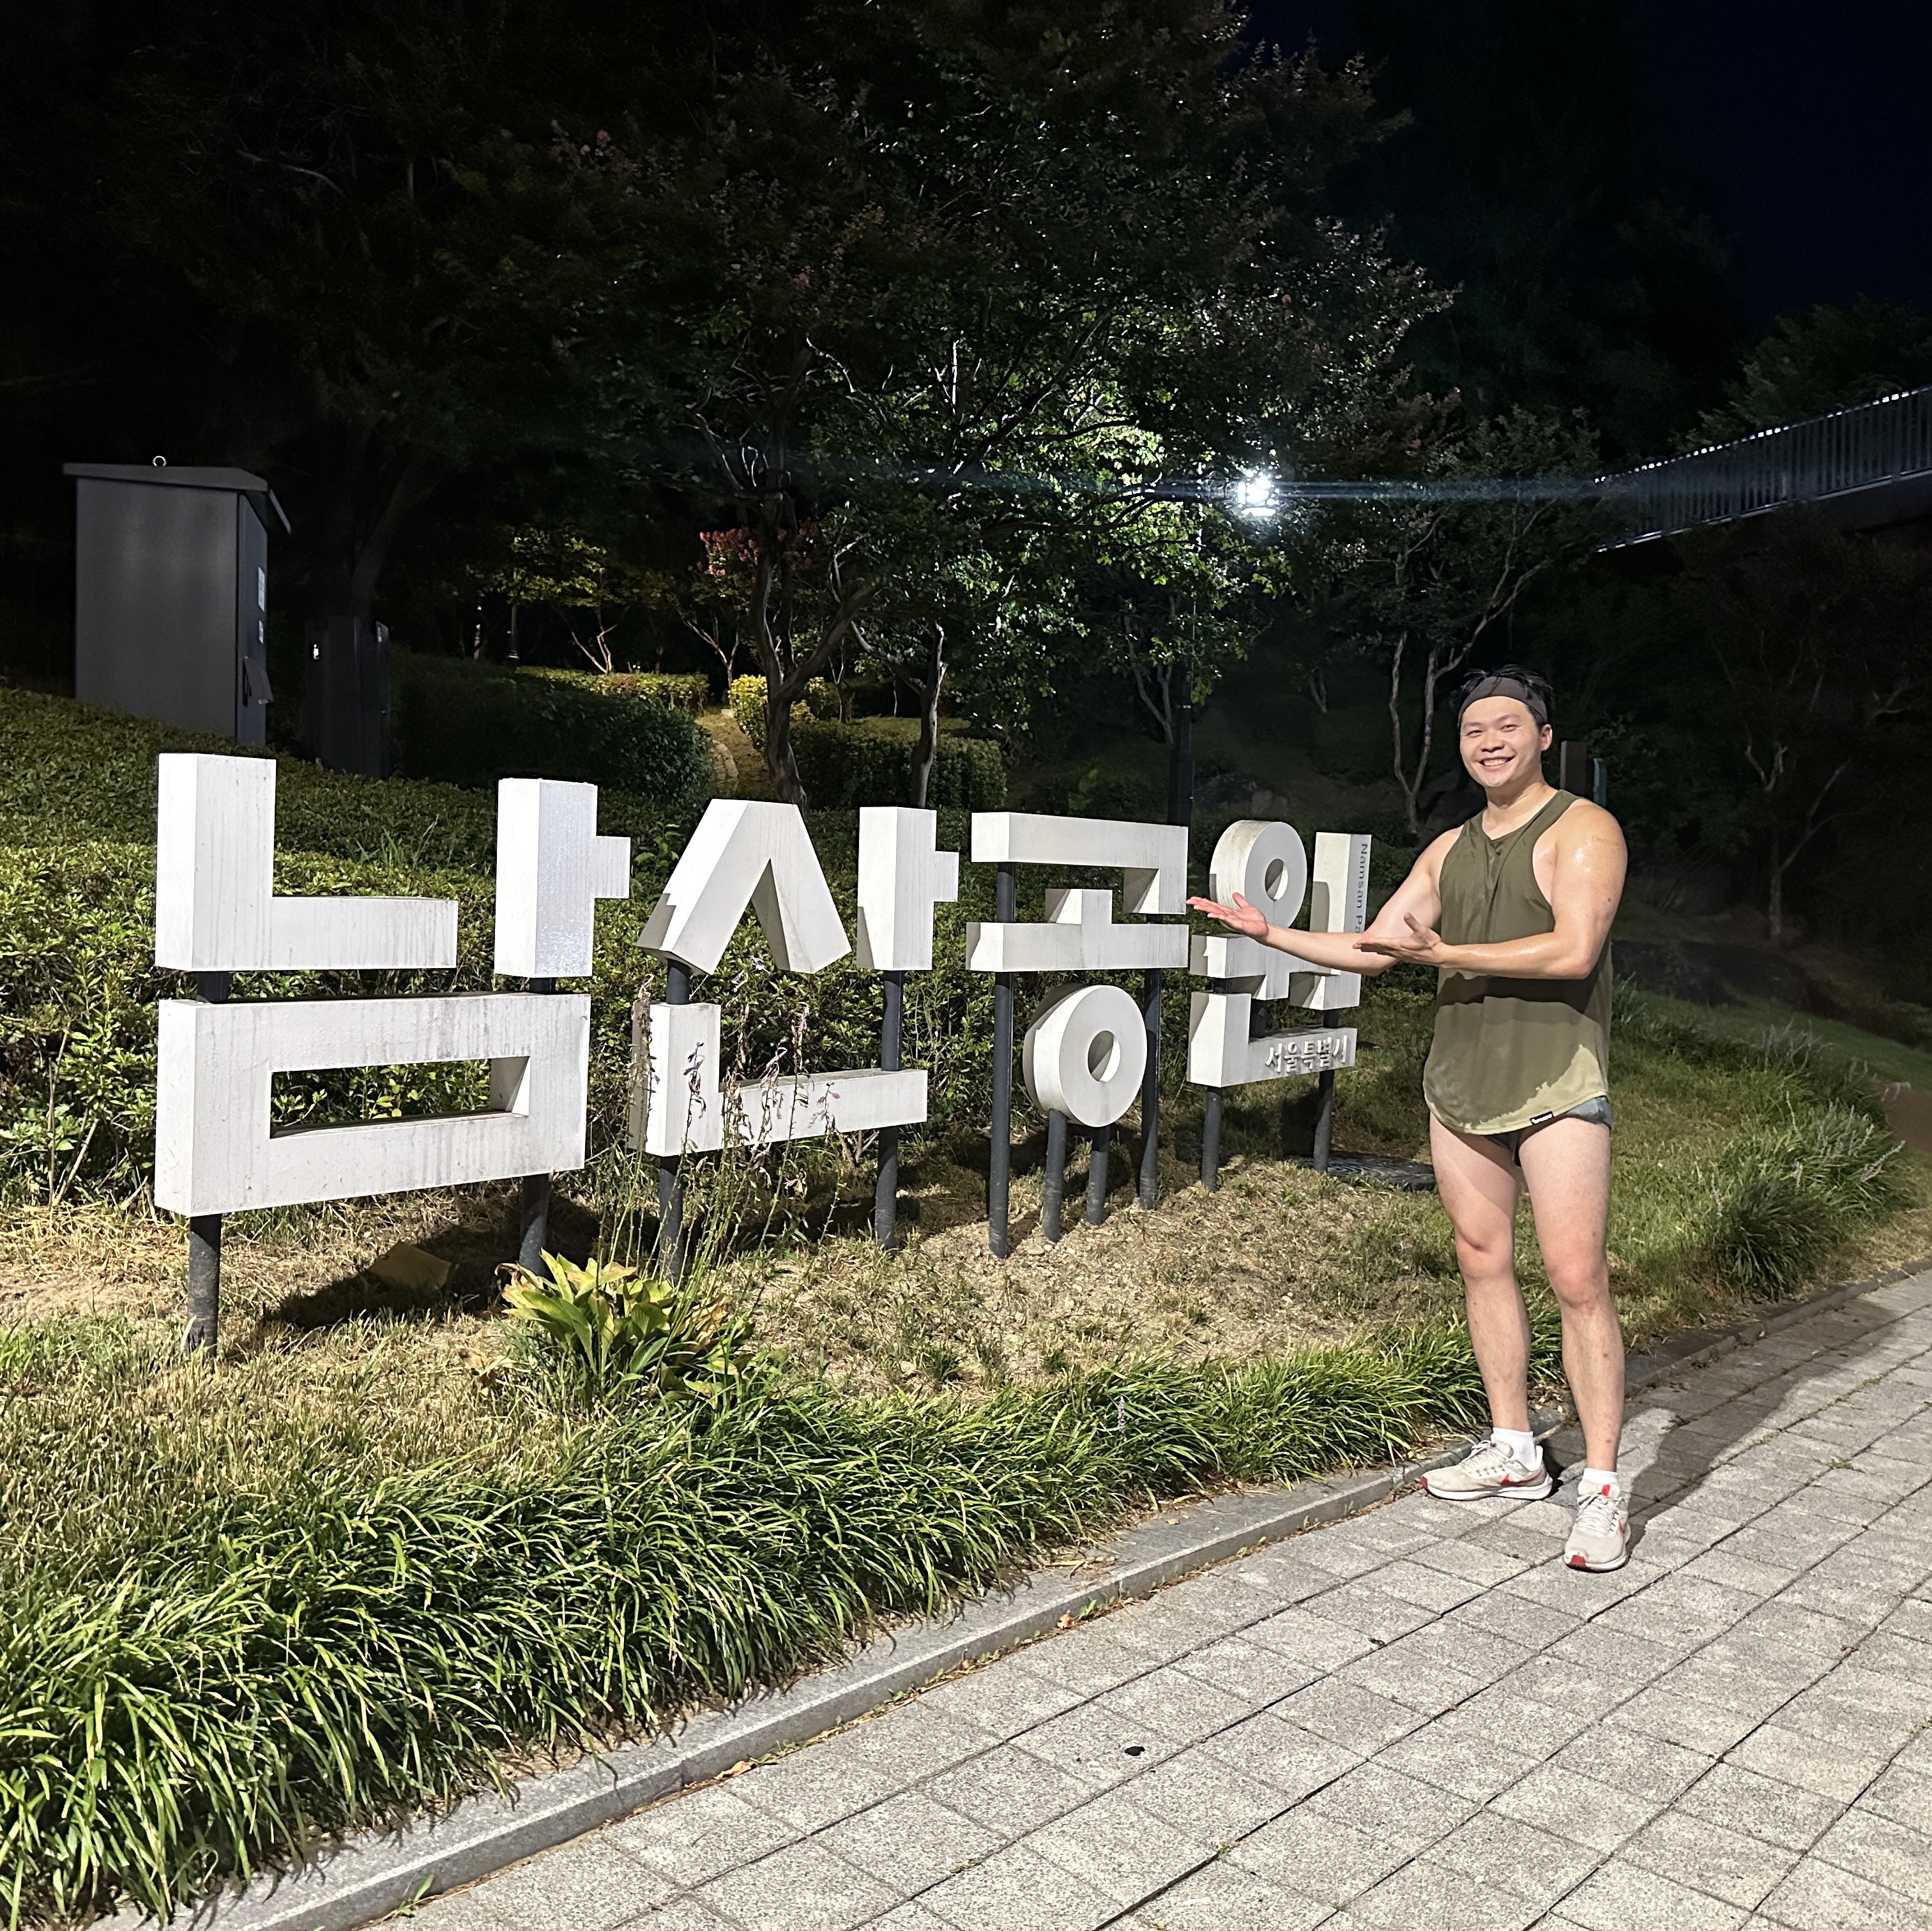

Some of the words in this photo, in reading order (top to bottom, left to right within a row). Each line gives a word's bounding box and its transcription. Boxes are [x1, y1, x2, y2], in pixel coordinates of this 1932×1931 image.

[1357, 844, 1368, 909] Namsan
[1355, 915, 1363, 934] Pa
[155, 751, 1373, 1217] 남산공원
[1265, 1034, 1348, 1073] 서울특별시
